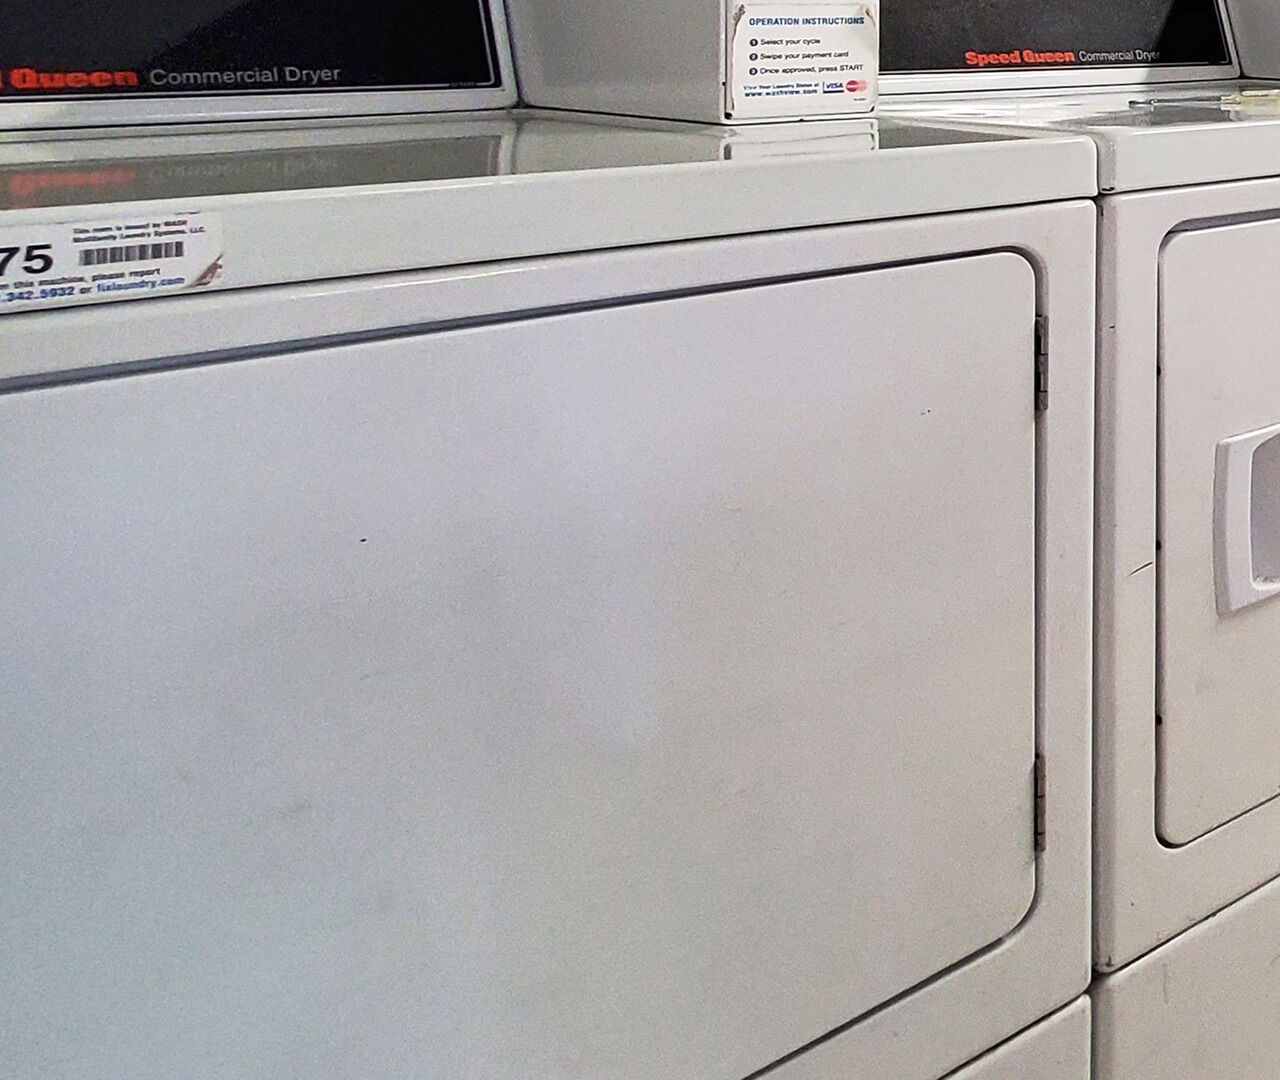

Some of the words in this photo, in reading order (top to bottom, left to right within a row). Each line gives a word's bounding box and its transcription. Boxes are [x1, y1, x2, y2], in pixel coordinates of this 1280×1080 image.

[749, 17, 800, 26] OPERATION
[802, 16, 865, 25] INSTRUCTIONS
[965, 49, 1020, 66] Speed
[1023, 48, 1075, 63] Queen
[1078, 50, 1134, 62] Commercial
[1135, 49, 1160, 64] Dryer
[819, 65, 837, 73] press
[10, 67, 138, 89] Queen
[150, 66, 278, 86] Commercial
[285, 66, 342, 85] Dryer
[13, 279, 35, 289] this
[129, 267, 161, 280] report
[80, 286, 92, 295] or
